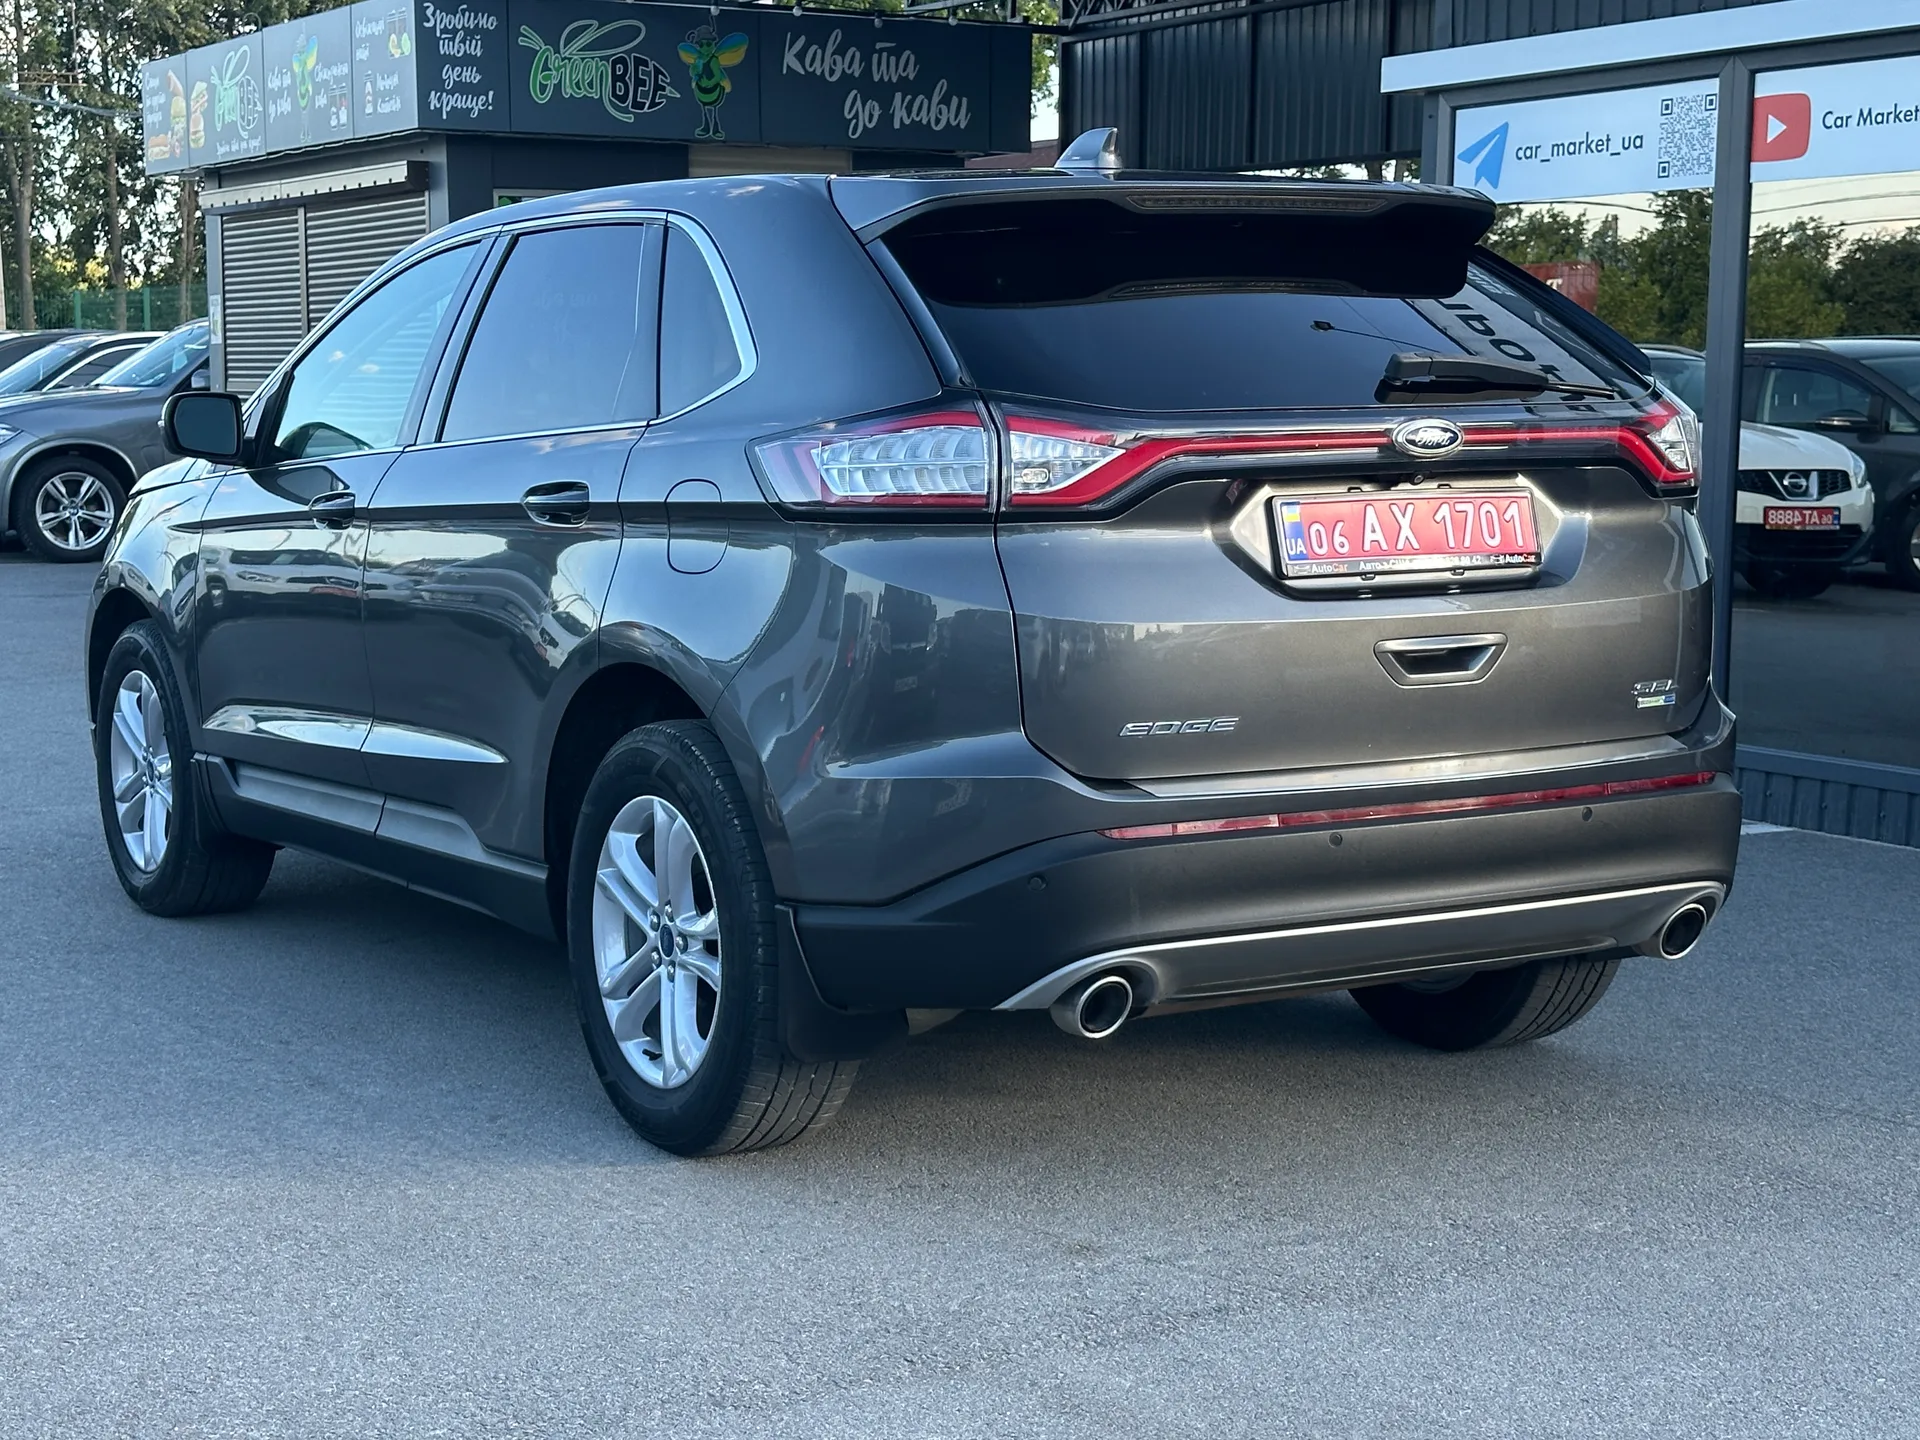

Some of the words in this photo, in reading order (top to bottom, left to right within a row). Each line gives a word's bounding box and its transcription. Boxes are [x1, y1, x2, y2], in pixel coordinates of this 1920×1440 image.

[423, 2, 498, 37] Зробимо
[439, 30, 483, 57] твій
[782, 28, 865, 82] Кава
[871, 42, 920, 83] та
[442, 64, 482, 90] день
[428, 90, 494, 120] краще!
[843, 89, 882, 139] до
[889, 79, 971, 131] кави
[1822, 110, 1852, 130] Car
[1856, 102, 1920, 127] Market
[1515, 131, 1643, 163] car_market_ua
[1407, 428, 1454, 446] Ford
[1308, 520, 1350, 556] 06
[1361, 502, 1421, 552] AX
[1432, 500, 1526, 548] 1701
[1287, 538, 1307, 556] UA
[1311, 563, 1349, 574] AutoCar
[1359, 560, 1381, 571] Авто
[1119, 717, 1240, 737] EDGE
